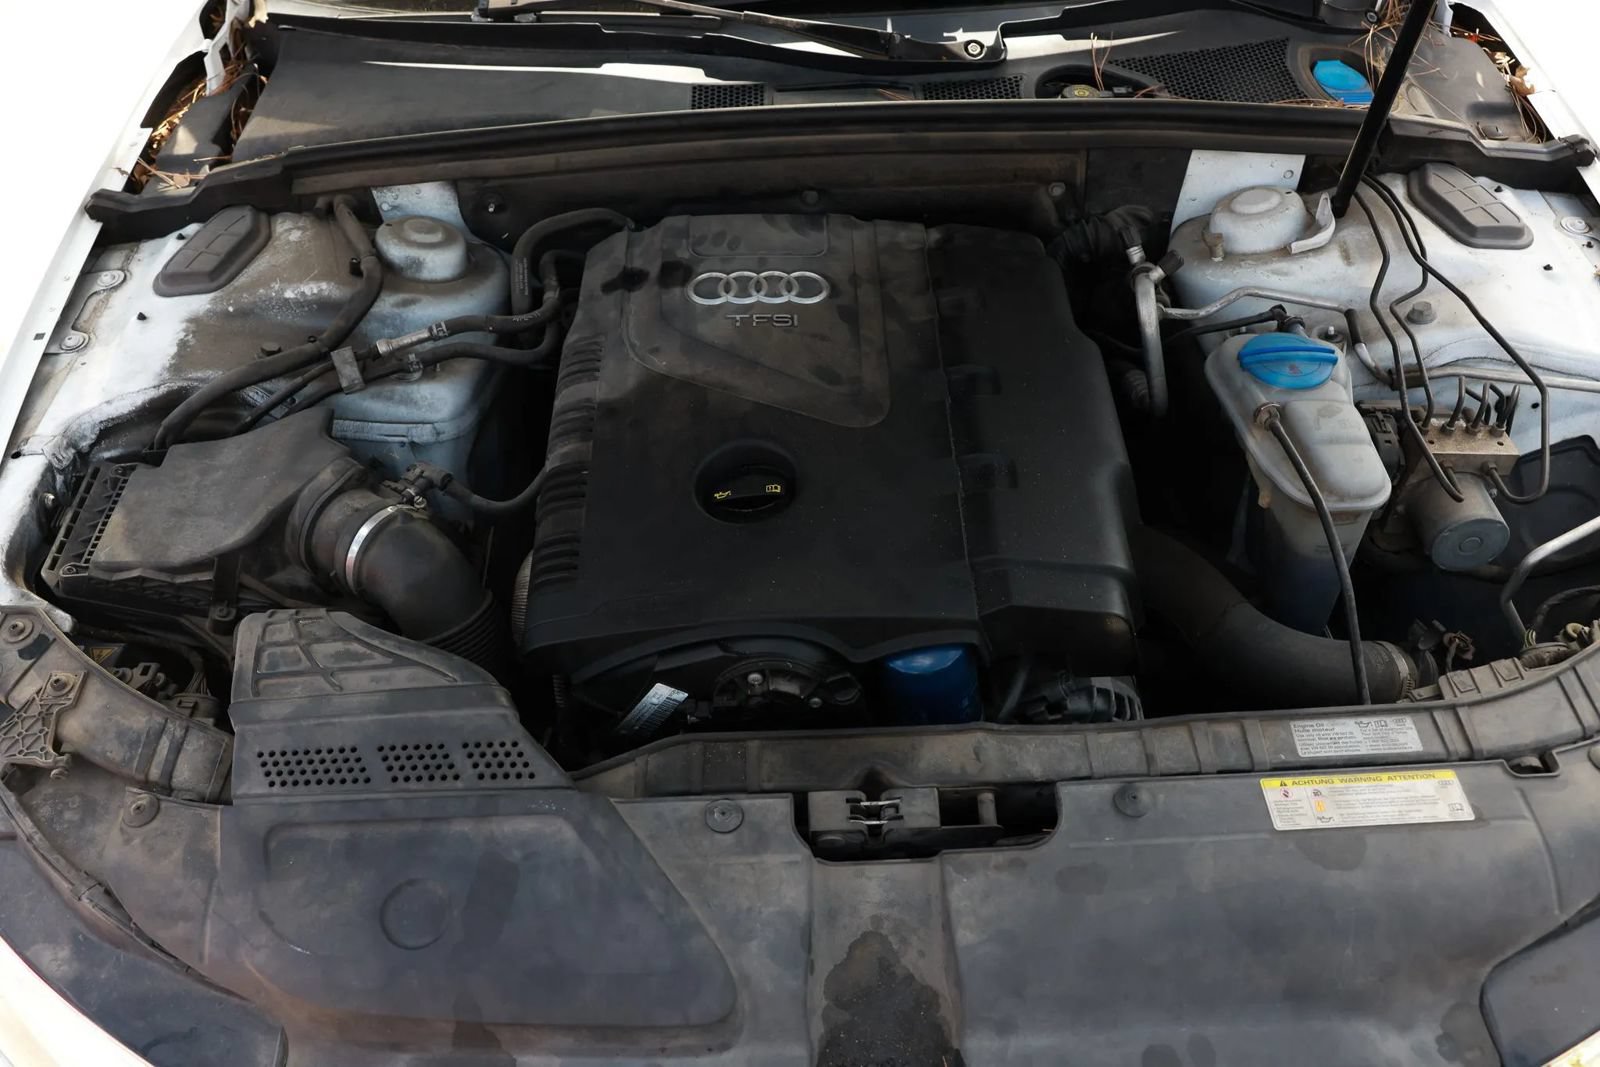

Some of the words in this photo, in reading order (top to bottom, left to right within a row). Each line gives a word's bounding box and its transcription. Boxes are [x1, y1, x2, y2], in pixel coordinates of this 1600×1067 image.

[726, 314, 799, 327] TFSI
[1291, 778, 1335, 786] ACHTUNG
[1339, 775, 1383, 784] WARNING
[1387, 773, 1436, 781] ATTENTION
